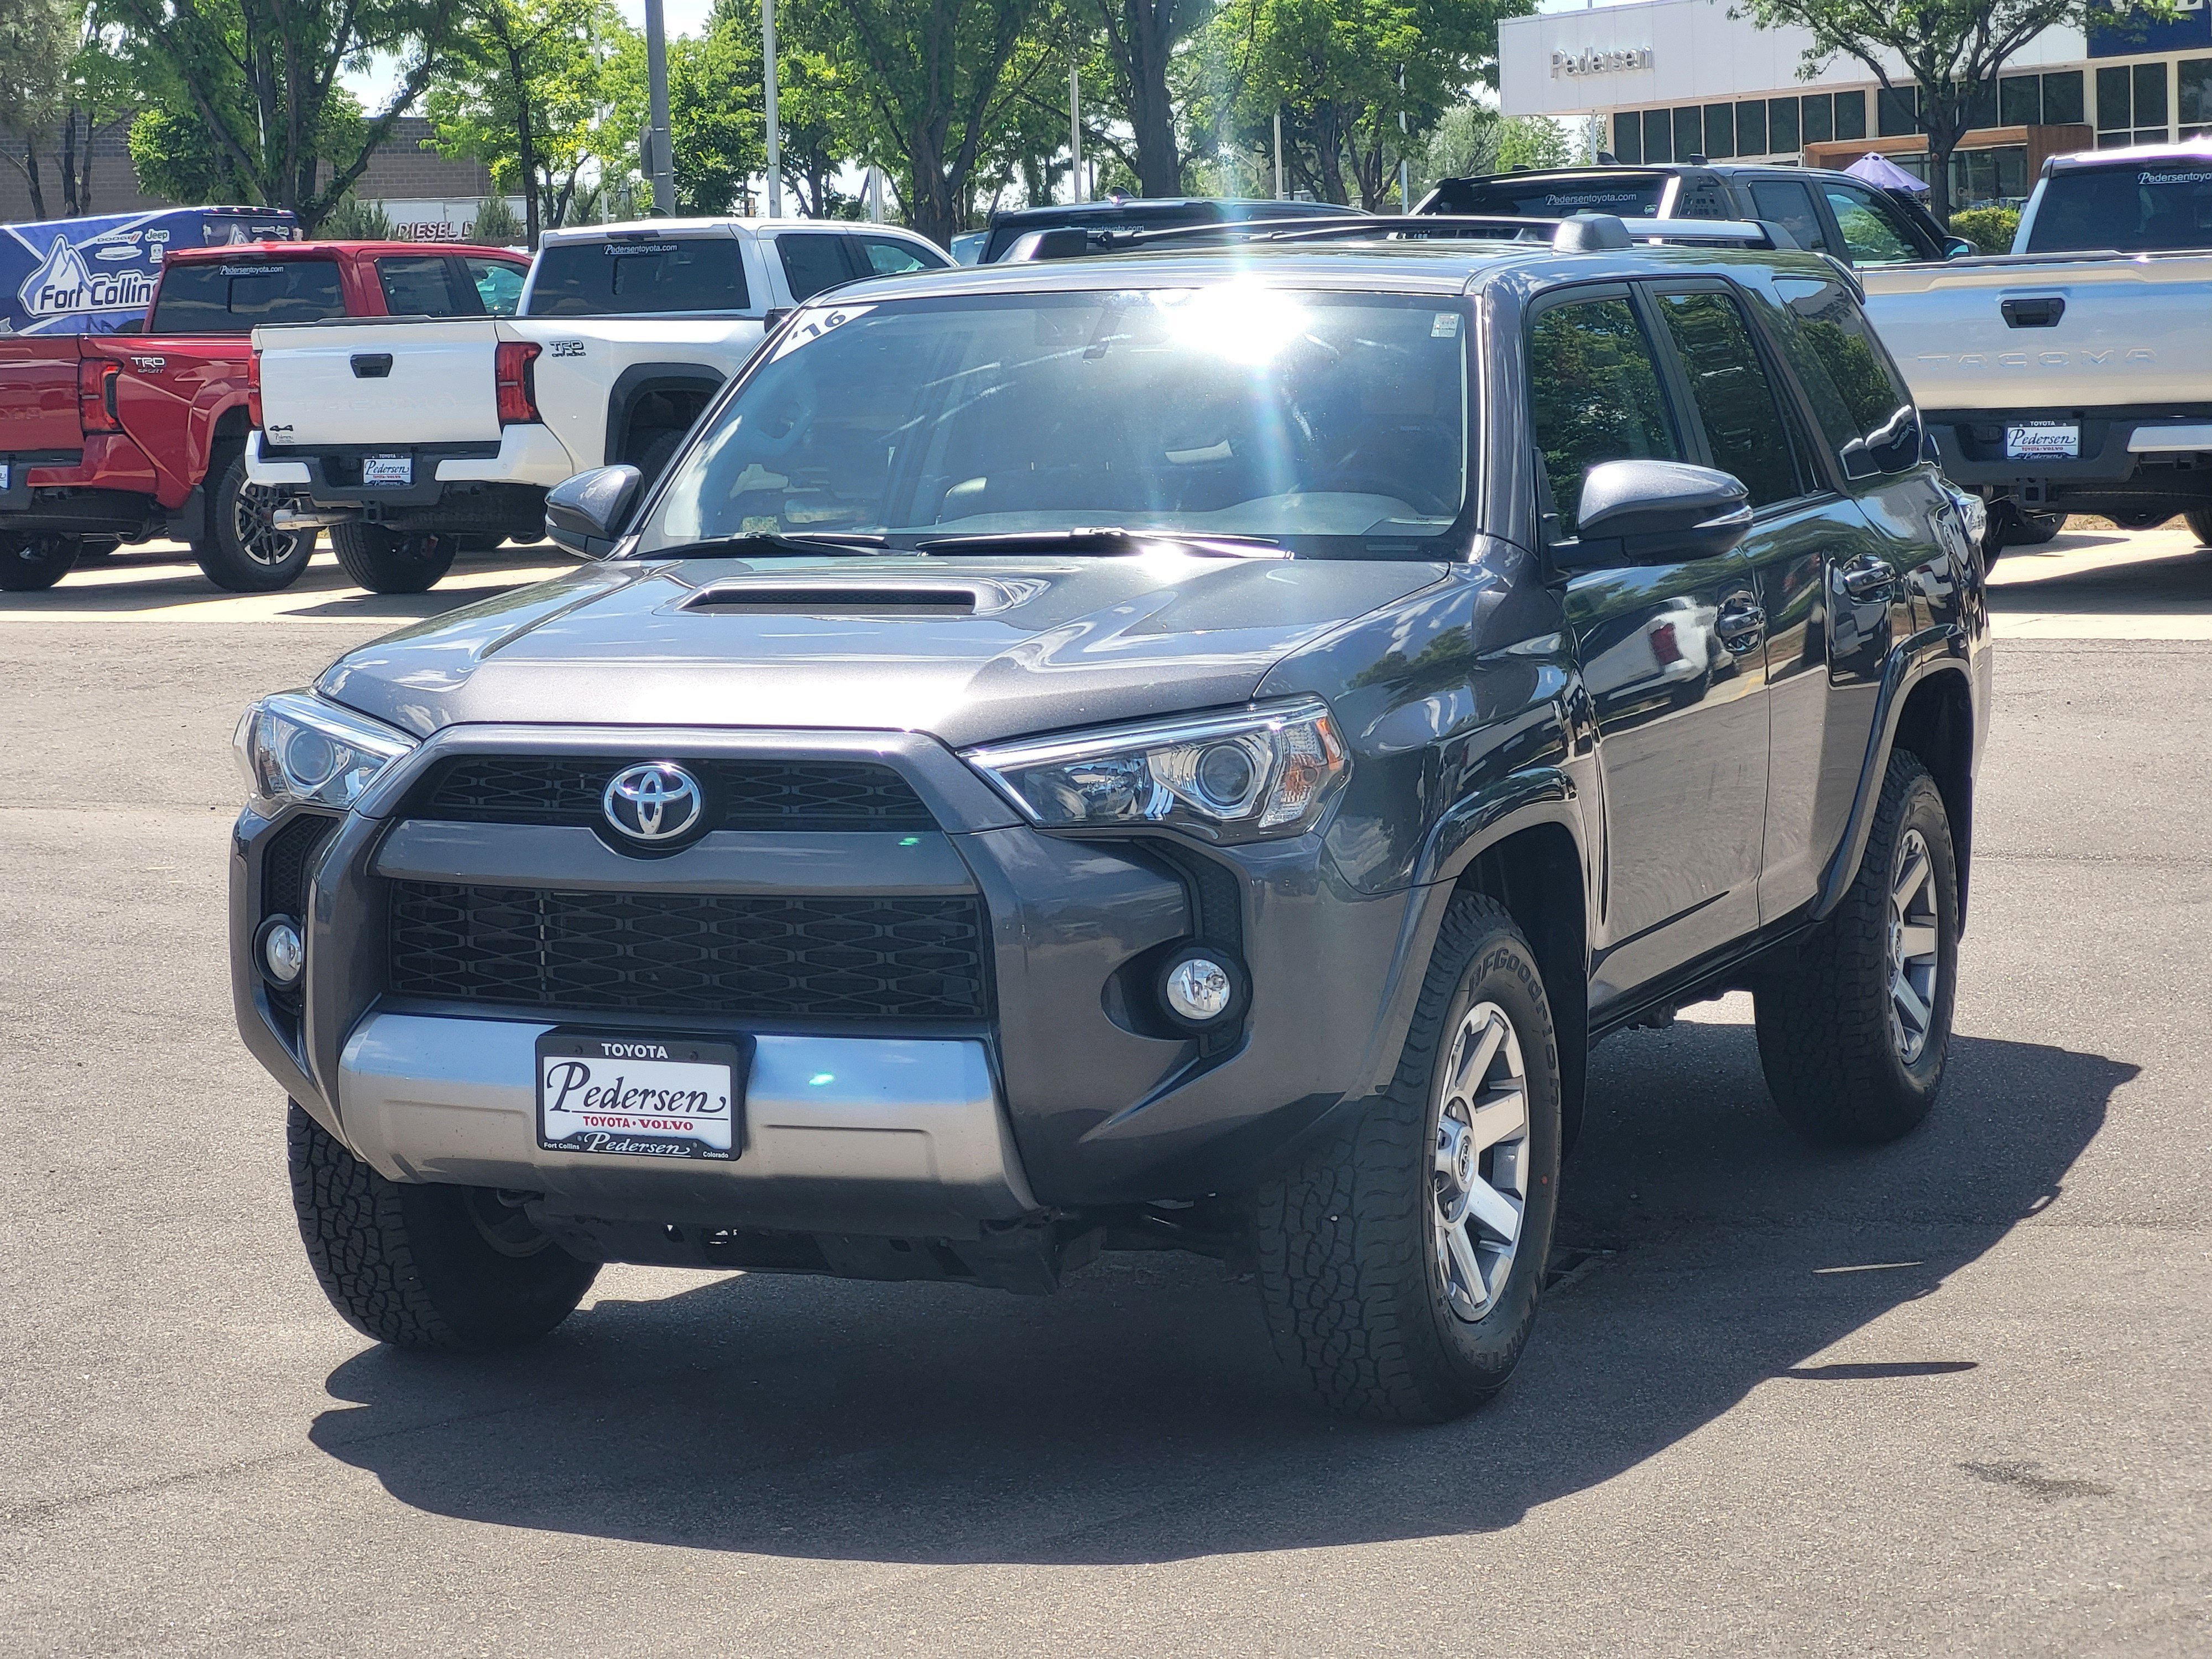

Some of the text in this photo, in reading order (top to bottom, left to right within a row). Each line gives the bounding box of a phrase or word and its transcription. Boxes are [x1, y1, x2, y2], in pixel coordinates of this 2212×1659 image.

[1550, 46, 1655, 79] Pedersen
[2138, 172, 2212, 184] Pedersentoyo
[1545, 194, 1636, 205] Pedersentoyota.com
[147, 231, 168, 240] Jeep
[397, 222, 458, 238] DIESEL
[604, 244, 677, 255] Pedersentoyota.com
[220, 265, 284, 275] Pedersentoyota.com
[40, 276, 155, 310] Fort Collin
[791, 310, 846, 340] '16
[549, 340, 584, 352] TRD
[131, 357, 165, 368] TRD
[1917, 348, 2157, 370] TACOMA
[2008, 429, 2076, 447] Pedersen
[365, 460, 409, 474] Pedersen
[601, 1043, 668, 1058] TOYOTA
[547, 1062, 726, 1113] Pedersen
[583, 1116, 693, 1130] TOYOTA VOLVO
[584, 1132, 690, 1154] Pedersen
